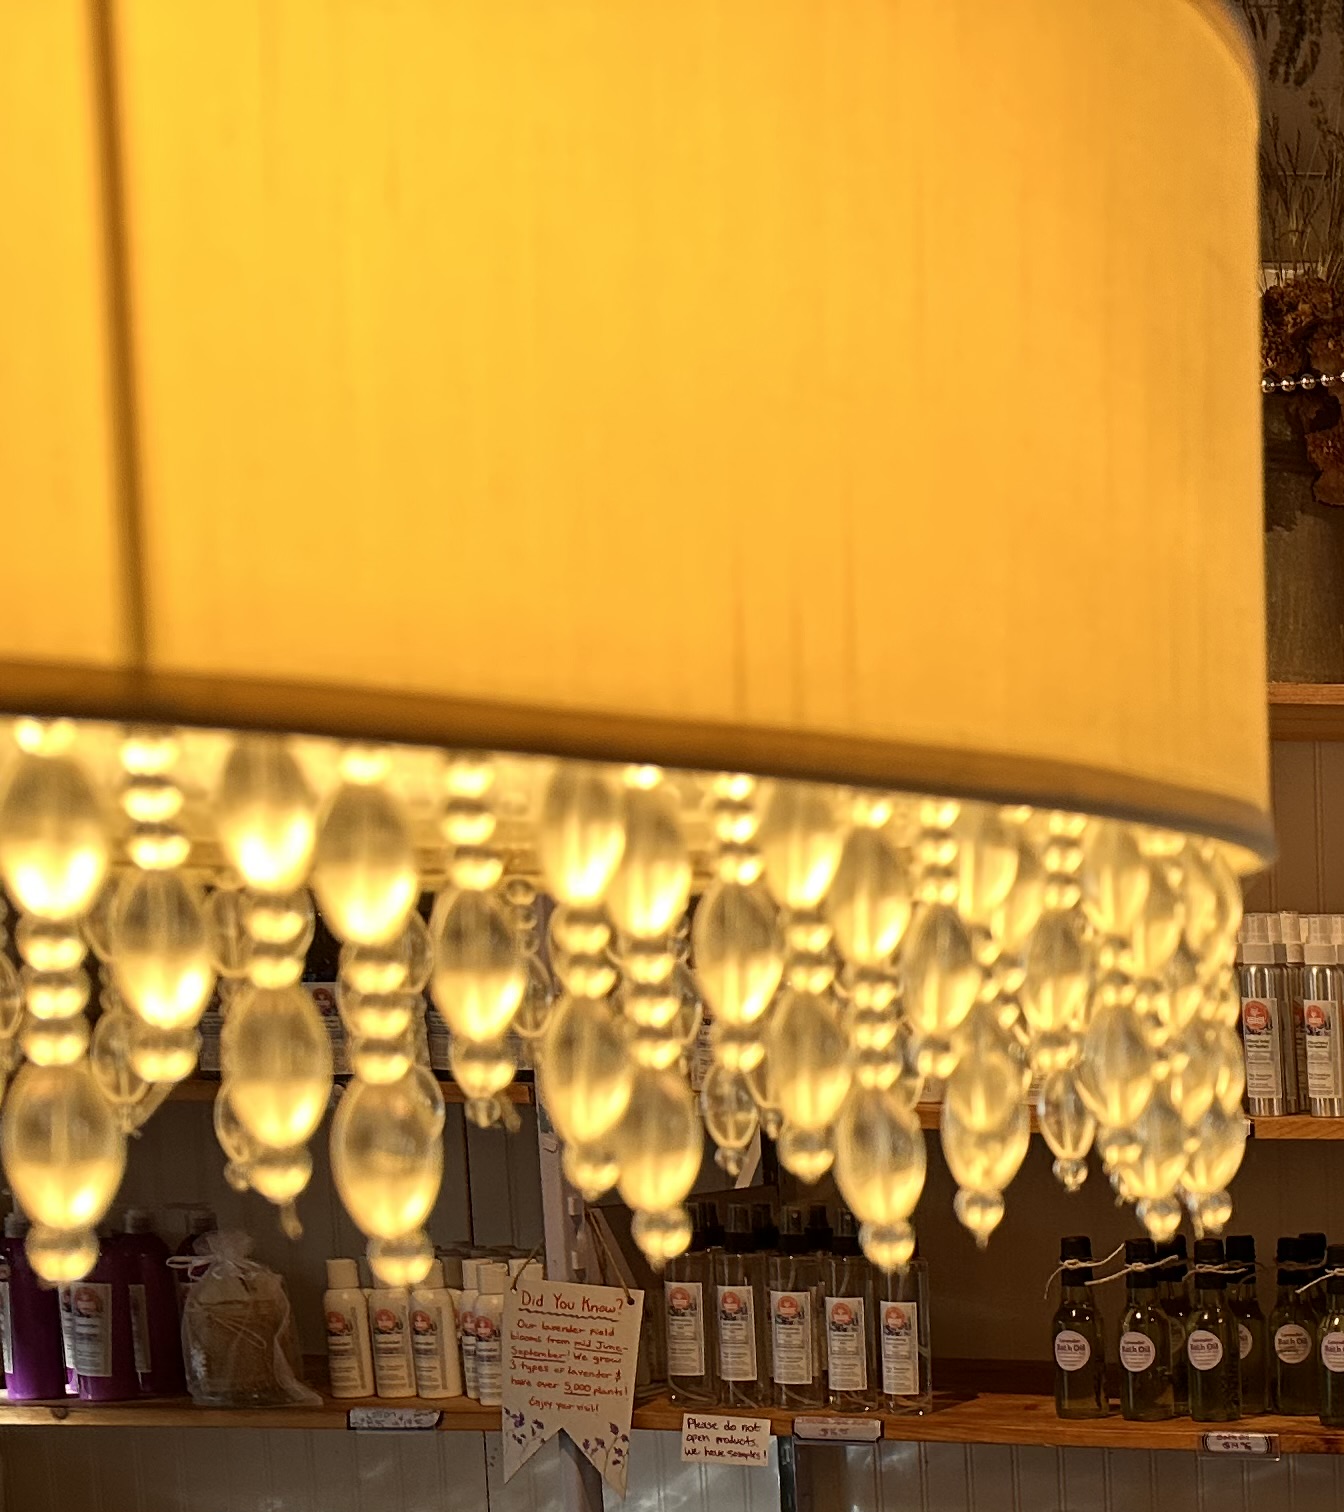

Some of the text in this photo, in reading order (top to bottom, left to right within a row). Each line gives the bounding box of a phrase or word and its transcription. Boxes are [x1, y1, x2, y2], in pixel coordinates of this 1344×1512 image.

[521, 1290, 624, 1315] Did You Know?
[516, 1319, 537, 1329] Our
[547, 1335, 570, 1345] from
[574, 1339, 591, 1348] mid
[593, 1355, 622, 1364] grow
[509, 1360, 517, 1369] 3
[521, 1361, 549, 1373] types
[510, 1376, 532, 1387] have
[536, 1380, 558, 1389] over
[564, 1381, 592, 1394] 5,000
[528, 1395, 553, 1410] Enjoy
[687, 1417, 762, 1433] Please do not
[686, 1434, 711, 1445] open
[704, 1446, 726, 1458] have
